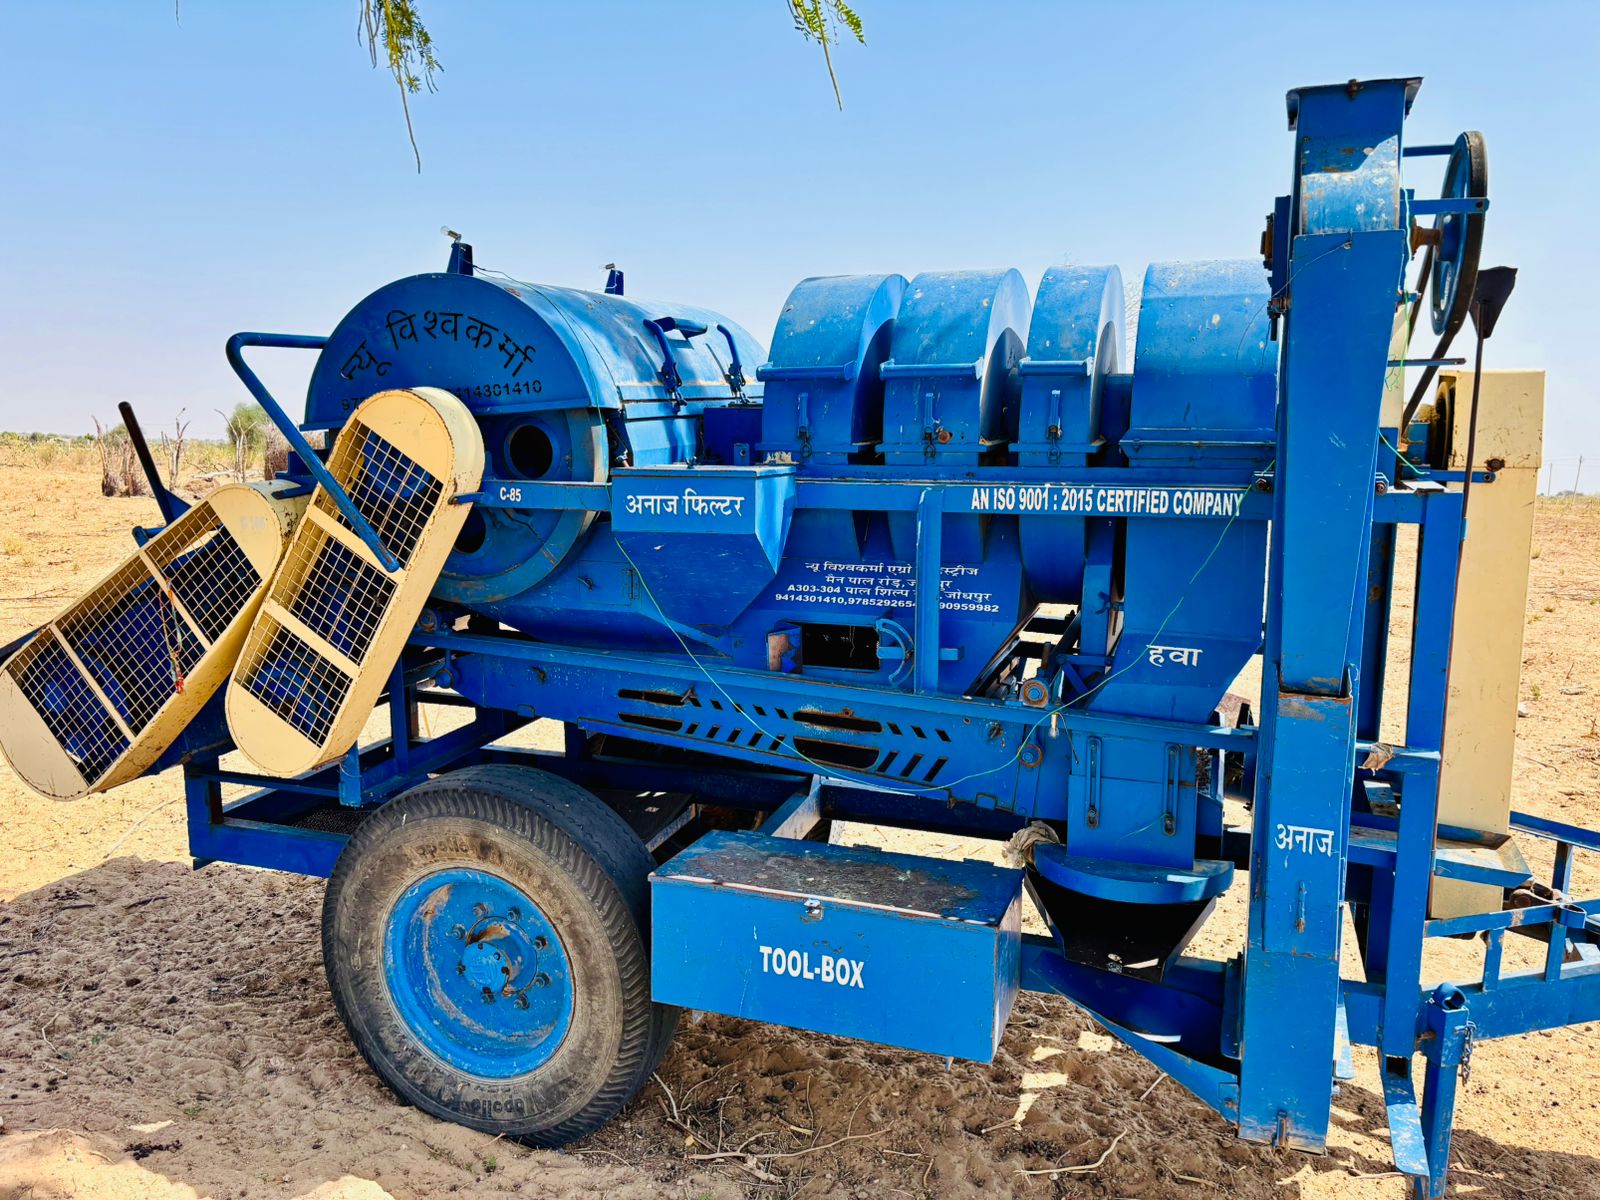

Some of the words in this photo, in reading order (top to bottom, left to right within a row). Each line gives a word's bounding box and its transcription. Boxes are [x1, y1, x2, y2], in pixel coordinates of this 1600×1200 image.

[445, 379, 543, 400] 414301410
[499, 486, 522, 502] C-85
[625, 494, 679, 516] अनाज
[682, 487, 745, 517] फिल्टर
[971, 488, 989, 511] AN
[993, 488, 1015, 511] ISO
[1018, 487, 1049, 511] 9001
[1061, 488, 1093, 512] 2015
[1096, 489, 1169, 515] CERTIFIED
[1172, 491, 1244, 517] COMPANY
[823, 561, 885, 573] विश्वकर्मा
[887, 563, 912, 575] एग्रो
[787, 584, 841, 594] A303-304
[845, 586, 871, 596] पाल
[874, 585, 910, 598] शिल्प
[848, 575, 874, 586] पाल
[1146, 644, 1204, 667] हवा
[1274, 823, 1335, 857] अनाज
[759, 945, 865, 989] TOOL-BOX
